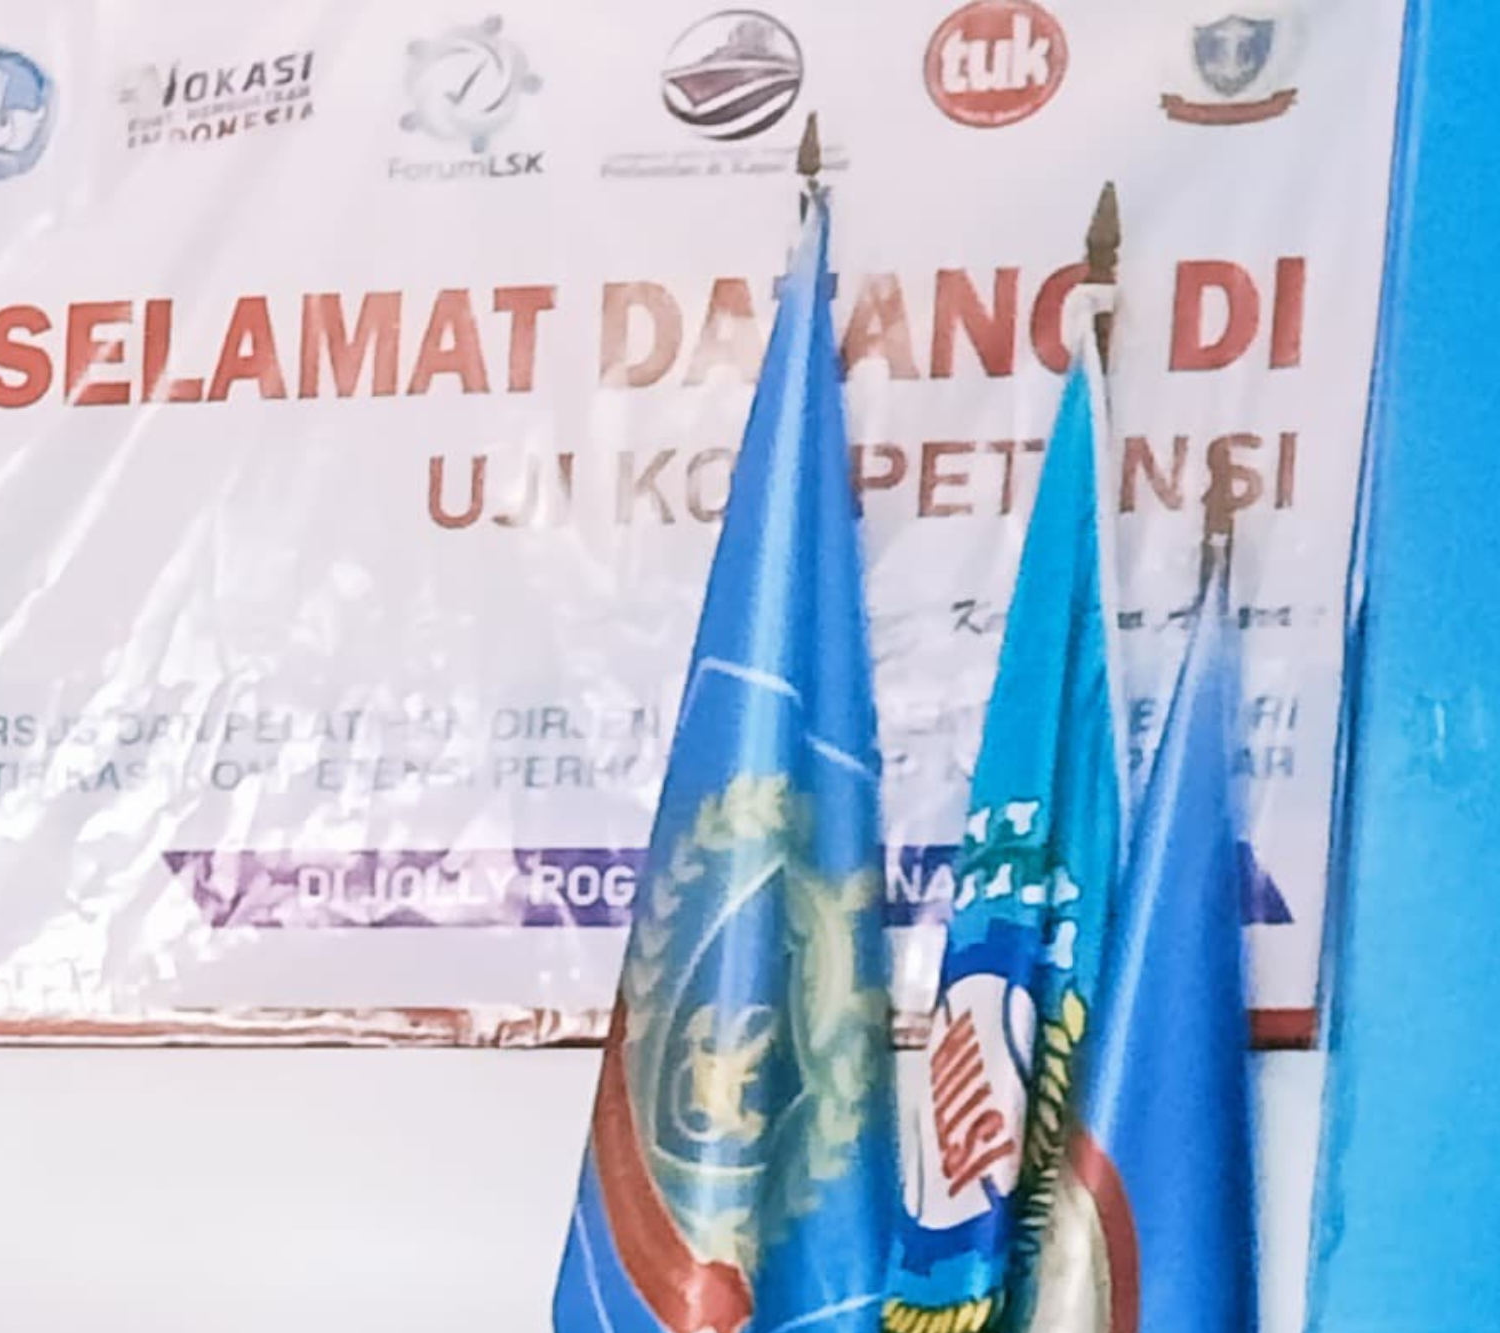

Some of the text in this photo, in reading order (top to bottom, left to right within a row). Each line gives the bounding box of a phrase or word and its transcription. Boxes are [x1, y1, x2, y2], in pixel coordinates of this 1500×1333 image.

[939, 14, 1050, 92] tuk
[388, 151, 545, 181] ForumLSK
[1168, 256, 1308, 373] DI
[612, 432, 1298, 526] KOPETNSI
[528, 862, 637, 906] ROG
